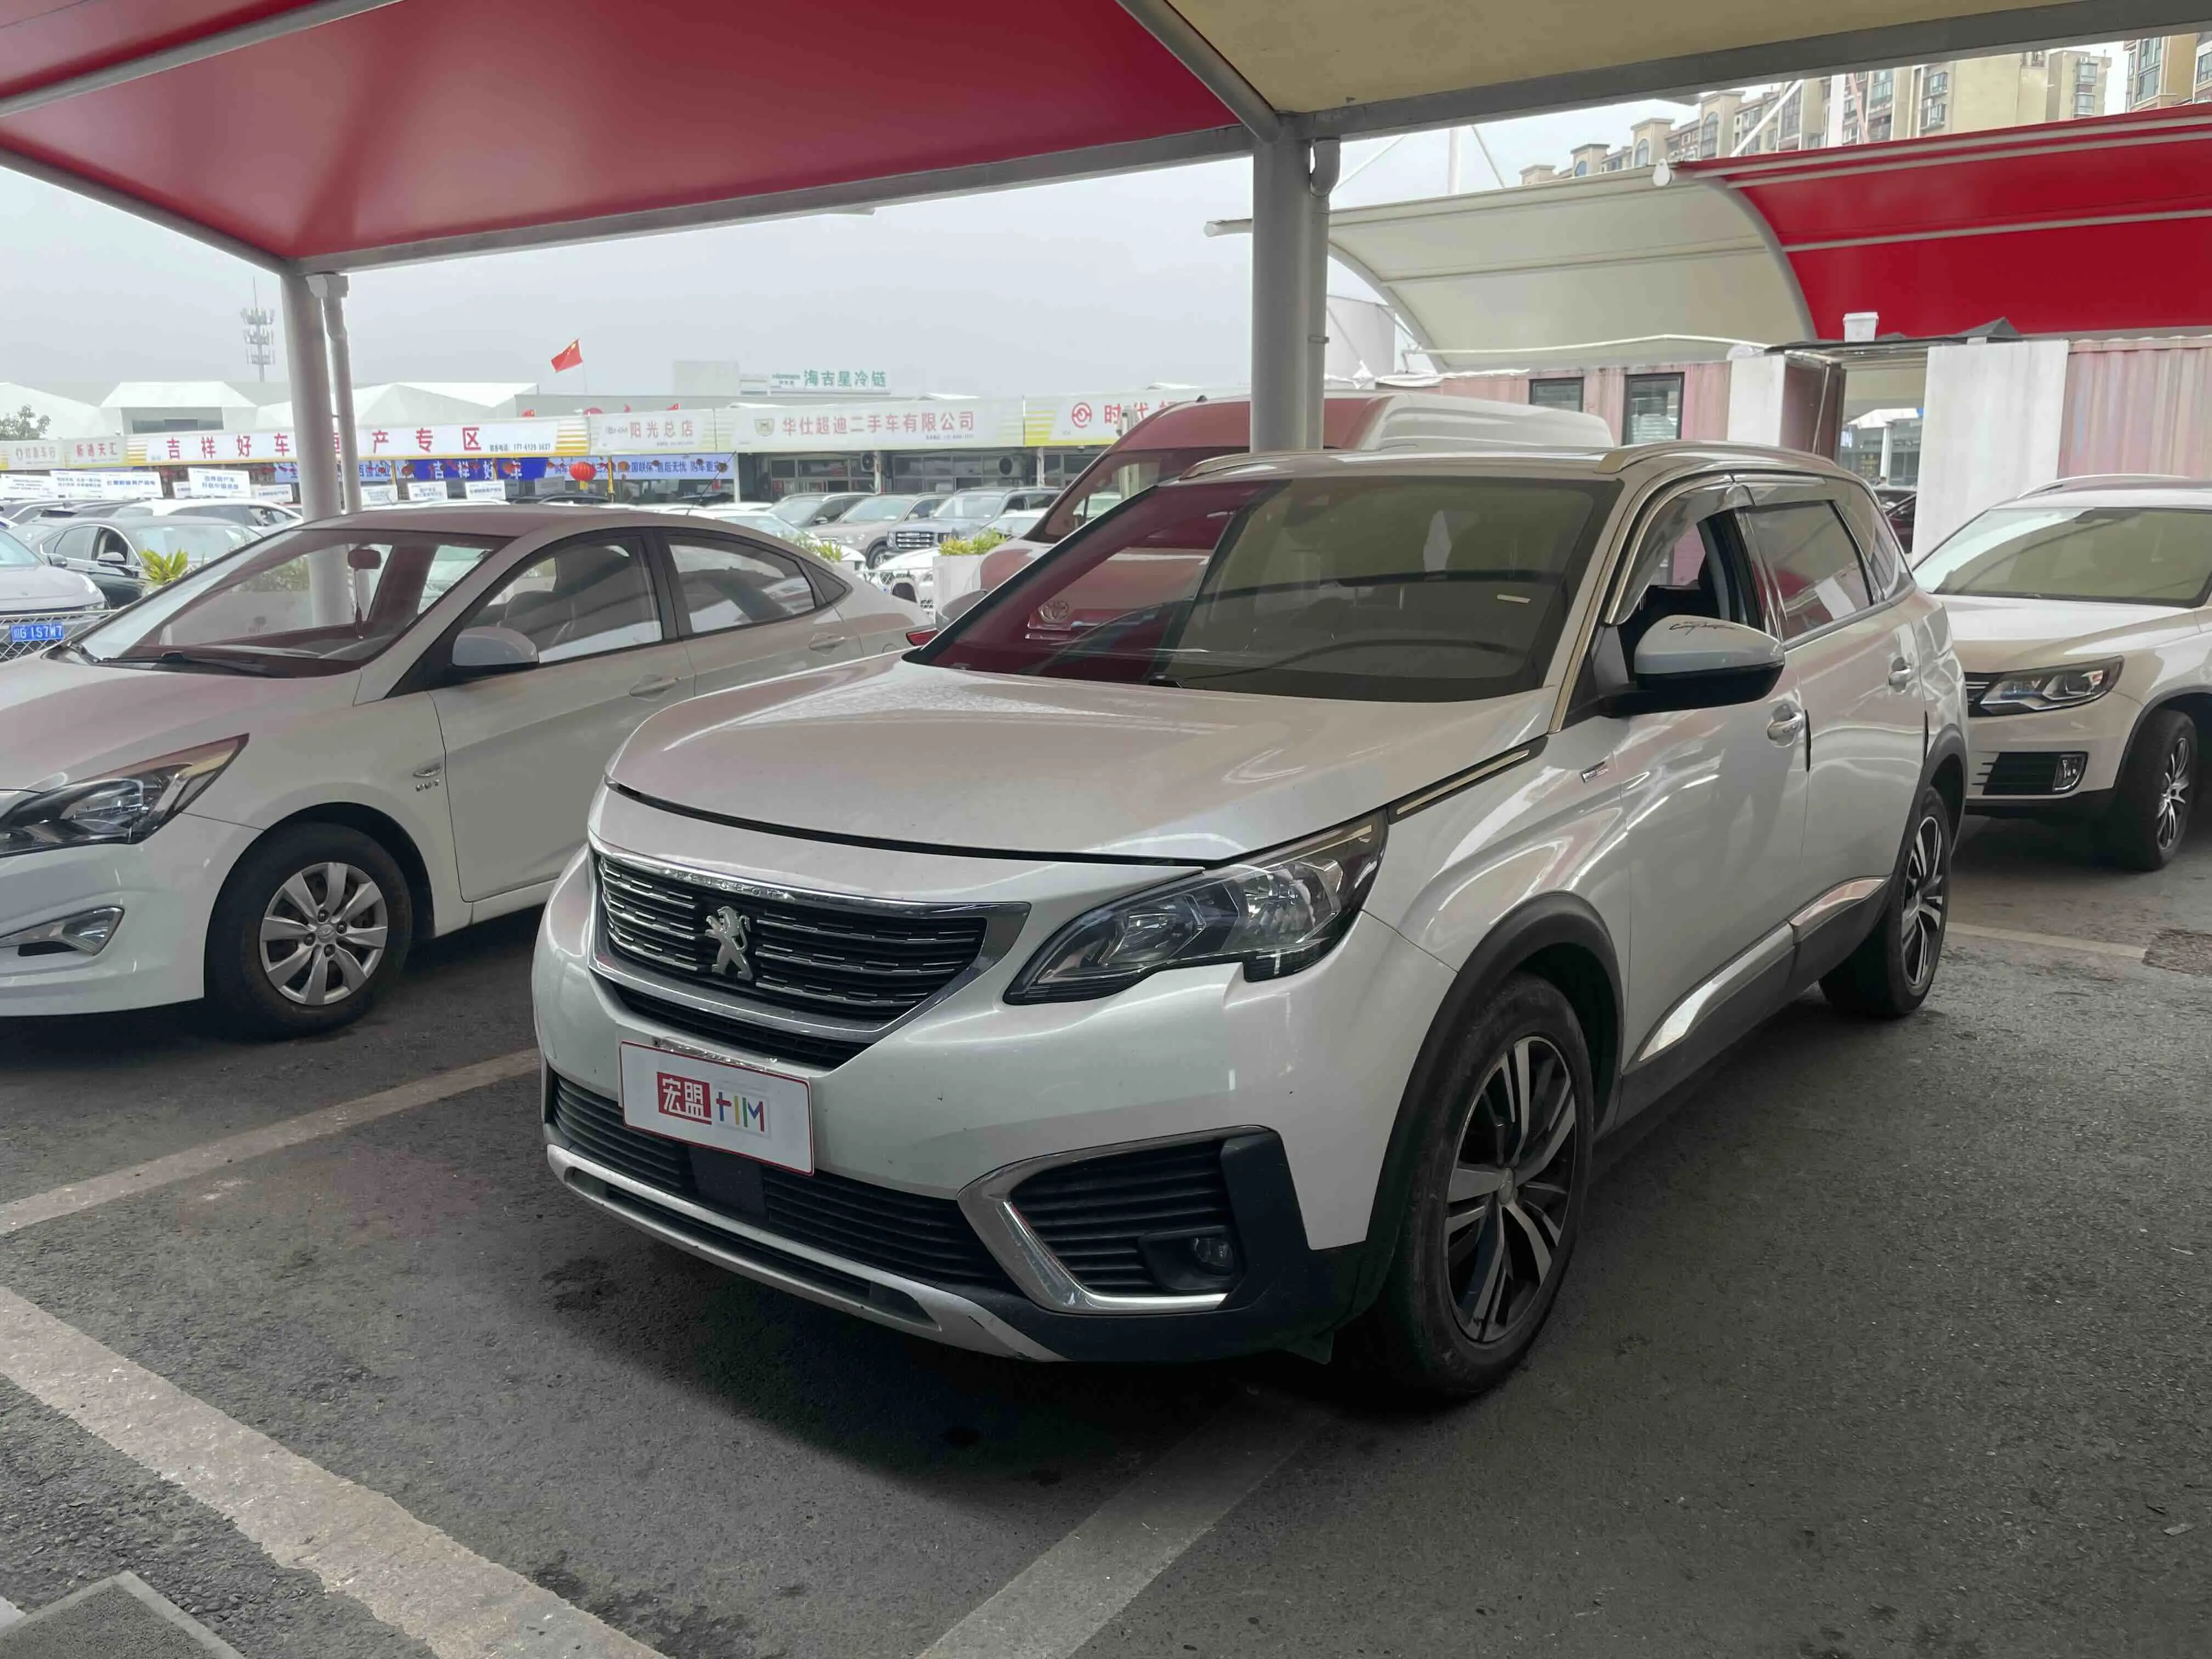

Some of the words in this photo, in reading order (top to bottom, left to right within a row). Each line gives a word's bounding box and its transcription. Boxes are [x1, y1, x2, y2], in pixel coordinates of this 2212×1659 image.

[803, 369, 887, 387] 海吉星冷链
[630, 419, 694, 438] 阳光总店
[782, 411, 975, 437] 华仕超迪二手车有限公司
